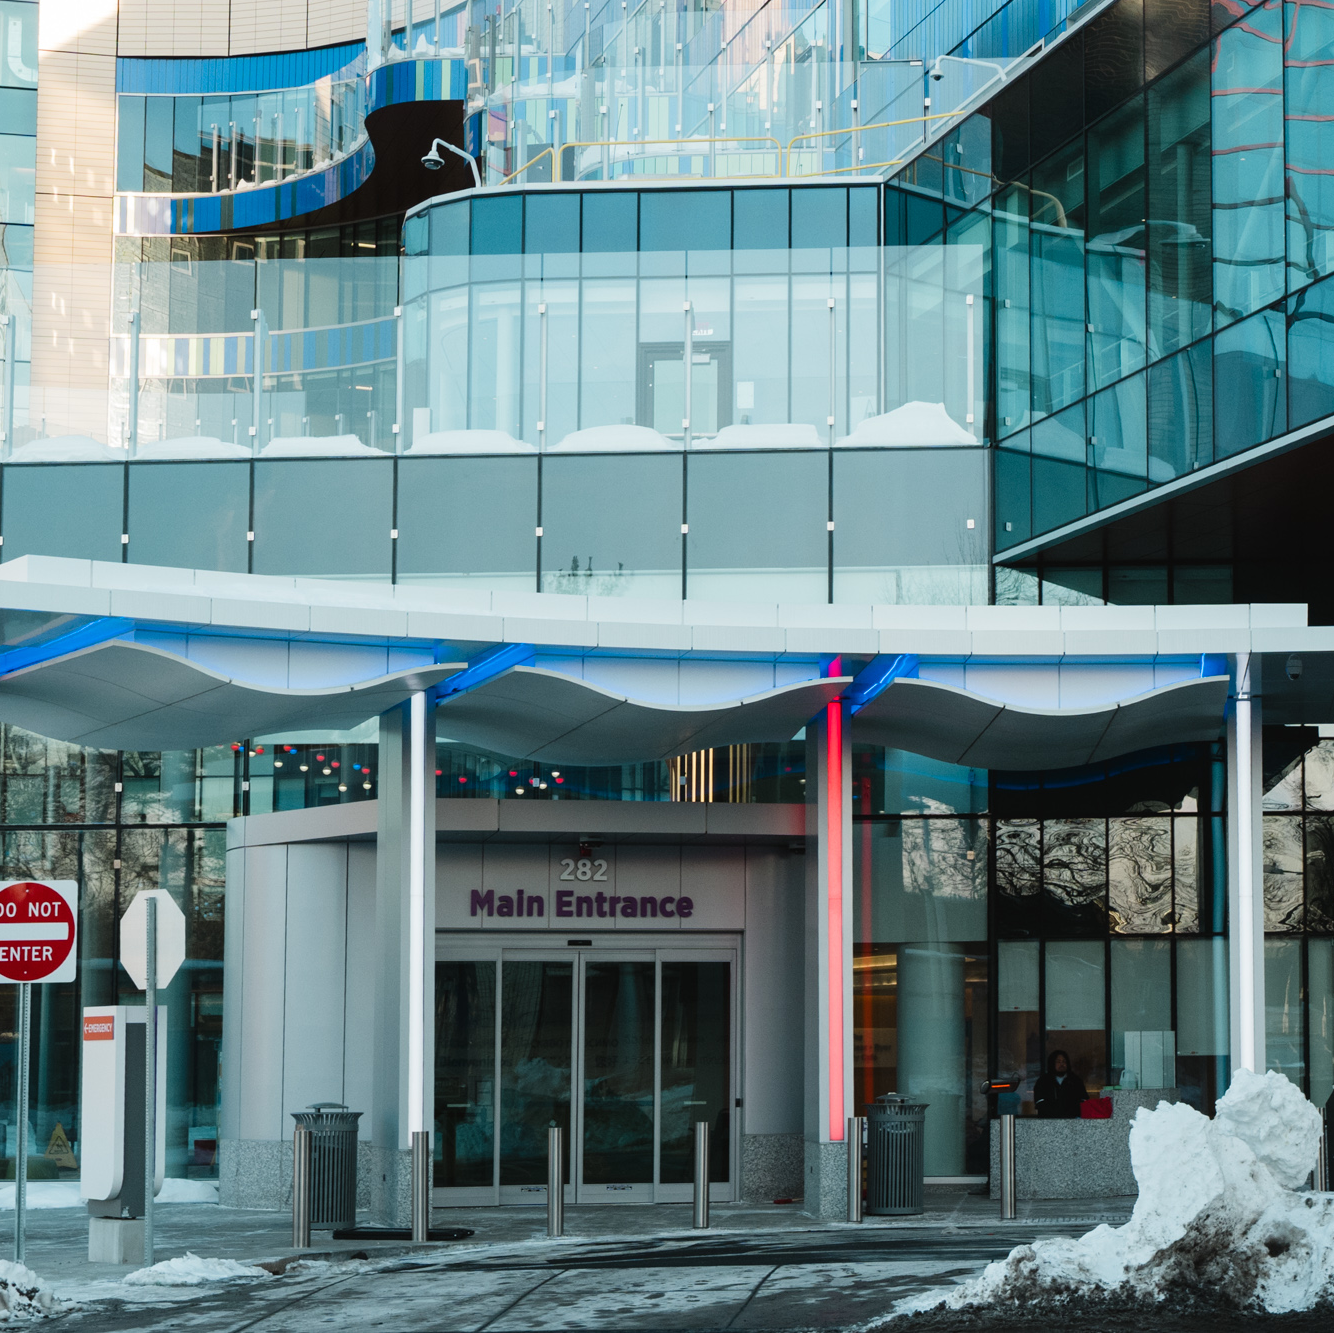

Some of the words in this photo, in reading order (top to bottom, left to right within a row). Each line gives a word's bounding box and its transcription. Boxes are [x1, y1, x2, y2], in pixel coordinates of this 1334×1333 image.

[560, 858, 608, 881] 282
[28, 901, 62, 918] NOT
[470, 889, 545, 917] Main
[555, 890, 694, 918] Entrance
[88, 1023, 113, 1033] EMERGENCY
